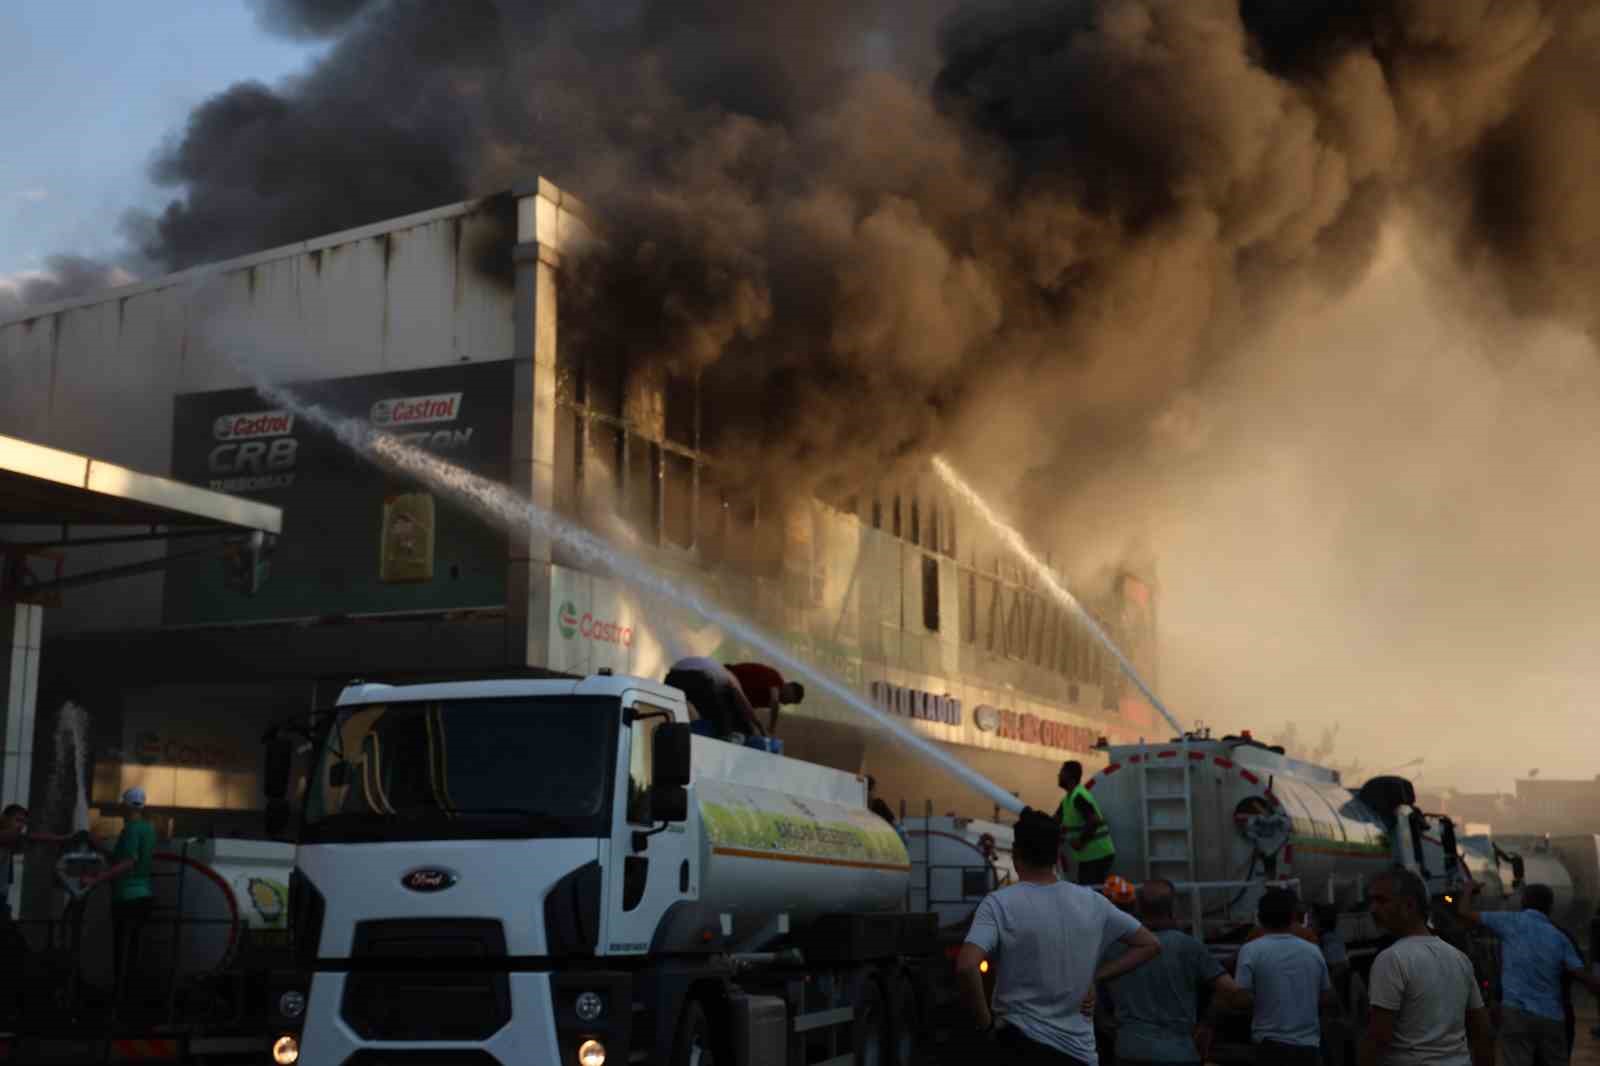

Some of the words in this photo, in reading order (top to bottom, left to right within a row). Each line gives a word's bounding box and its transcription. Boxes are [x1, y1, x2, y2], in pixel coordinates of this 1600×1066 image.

[392, 398, 454, 422] Castrol
[233, 415, 289, 436] Castrol
[579, 612, 634, 648] Castro
